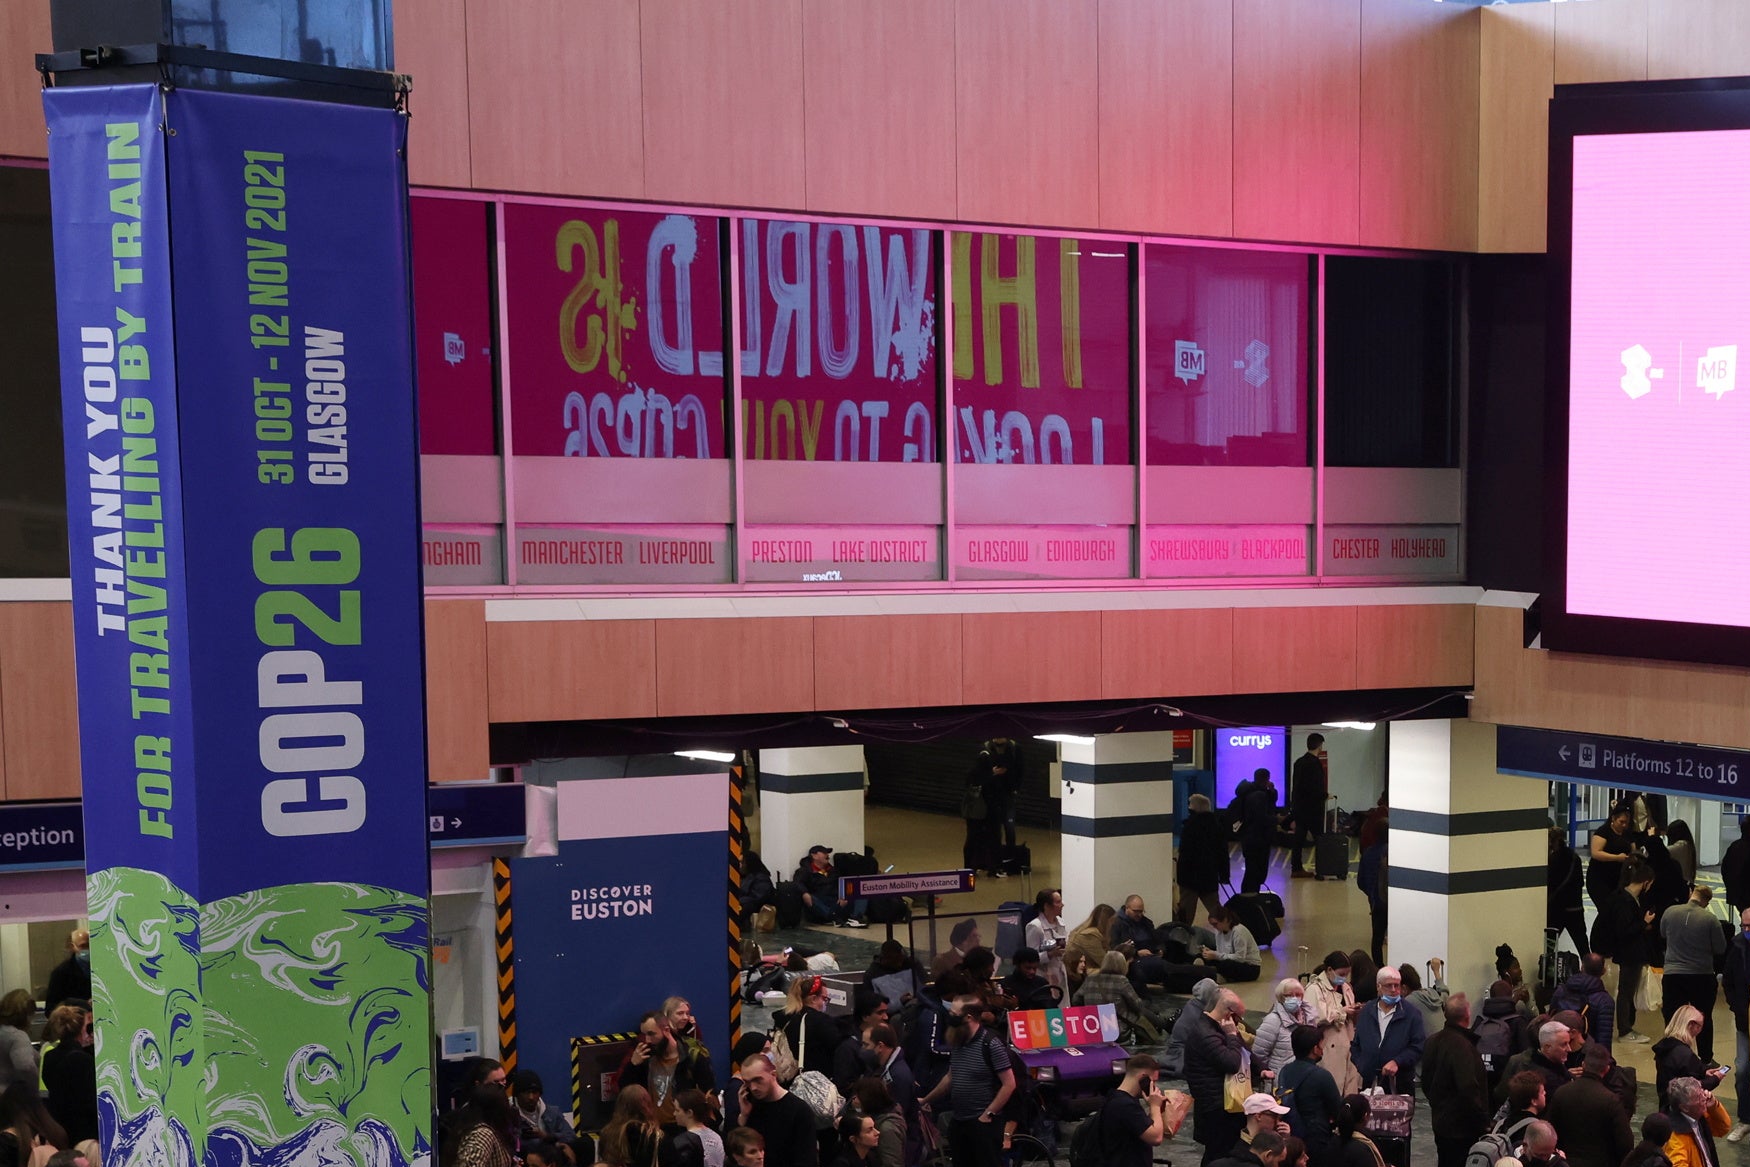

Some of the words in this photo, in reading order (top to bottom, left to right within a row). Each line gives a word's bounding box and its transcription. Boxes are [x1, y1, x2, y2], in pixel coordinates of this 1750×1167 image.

[244, 150, 287, 231] 2021
[106, 122, 143, 292] TRAIN
[247, 238, 289, 306] NOV
[116, 307, 150, 380] BY
[249, 314, 289, 348] 12
[81, 327, 118, 439] YOU
[1700, 360, 1728, 381] MB
[254, 378, 293, 440] OCT
[305, 326, 348, 485] GLASGOW
[258, 451, 294, 484] 31
[89, 454, 126, 635] THANK
[522, 541, 623, 565] MANCHESTER
[639, 541, 715, 564] LIVERPOOL
[752, 540, 812, 563] PRESTON
[832, 540, 865, 563] LAKE
[870, 540, 927, 563] DISTRICT
[968, 540, 1029, 563] GLASGOW
[1046, 540, 1116, 562] EDINBURGH
[1150, 538, 1229, 561] SHREWSBURY
[1241, 538, 1306, 560] BLACKPOOL
[1332, 538, 1380, 560] CHESTER
[1391, 537, 1447, 559] HOLYHEAD
[122, 399, 171, 719] TRAVELLING
[252, 527, 366, 837] COP26
[1229, 733, 1273, 749] currys
[1603, 748, 1671, 776] Platforms
[1675, 758, 1694, 778] 12
[1698, 763, 1713, 780] to
[1717, 762, 1739, 785] 16
[135, 735, 173, 839] FOR
[571, 885, 653, 901] DISCOVER
[862, 883, 888, 892] Euston
[889, 880, 919, 890] Mobility
[920, 879, 959, 888] Assistance
[571, 899, 653, 921] EUSTON
[1013, 1013, 1119, 1039] EUSTON
